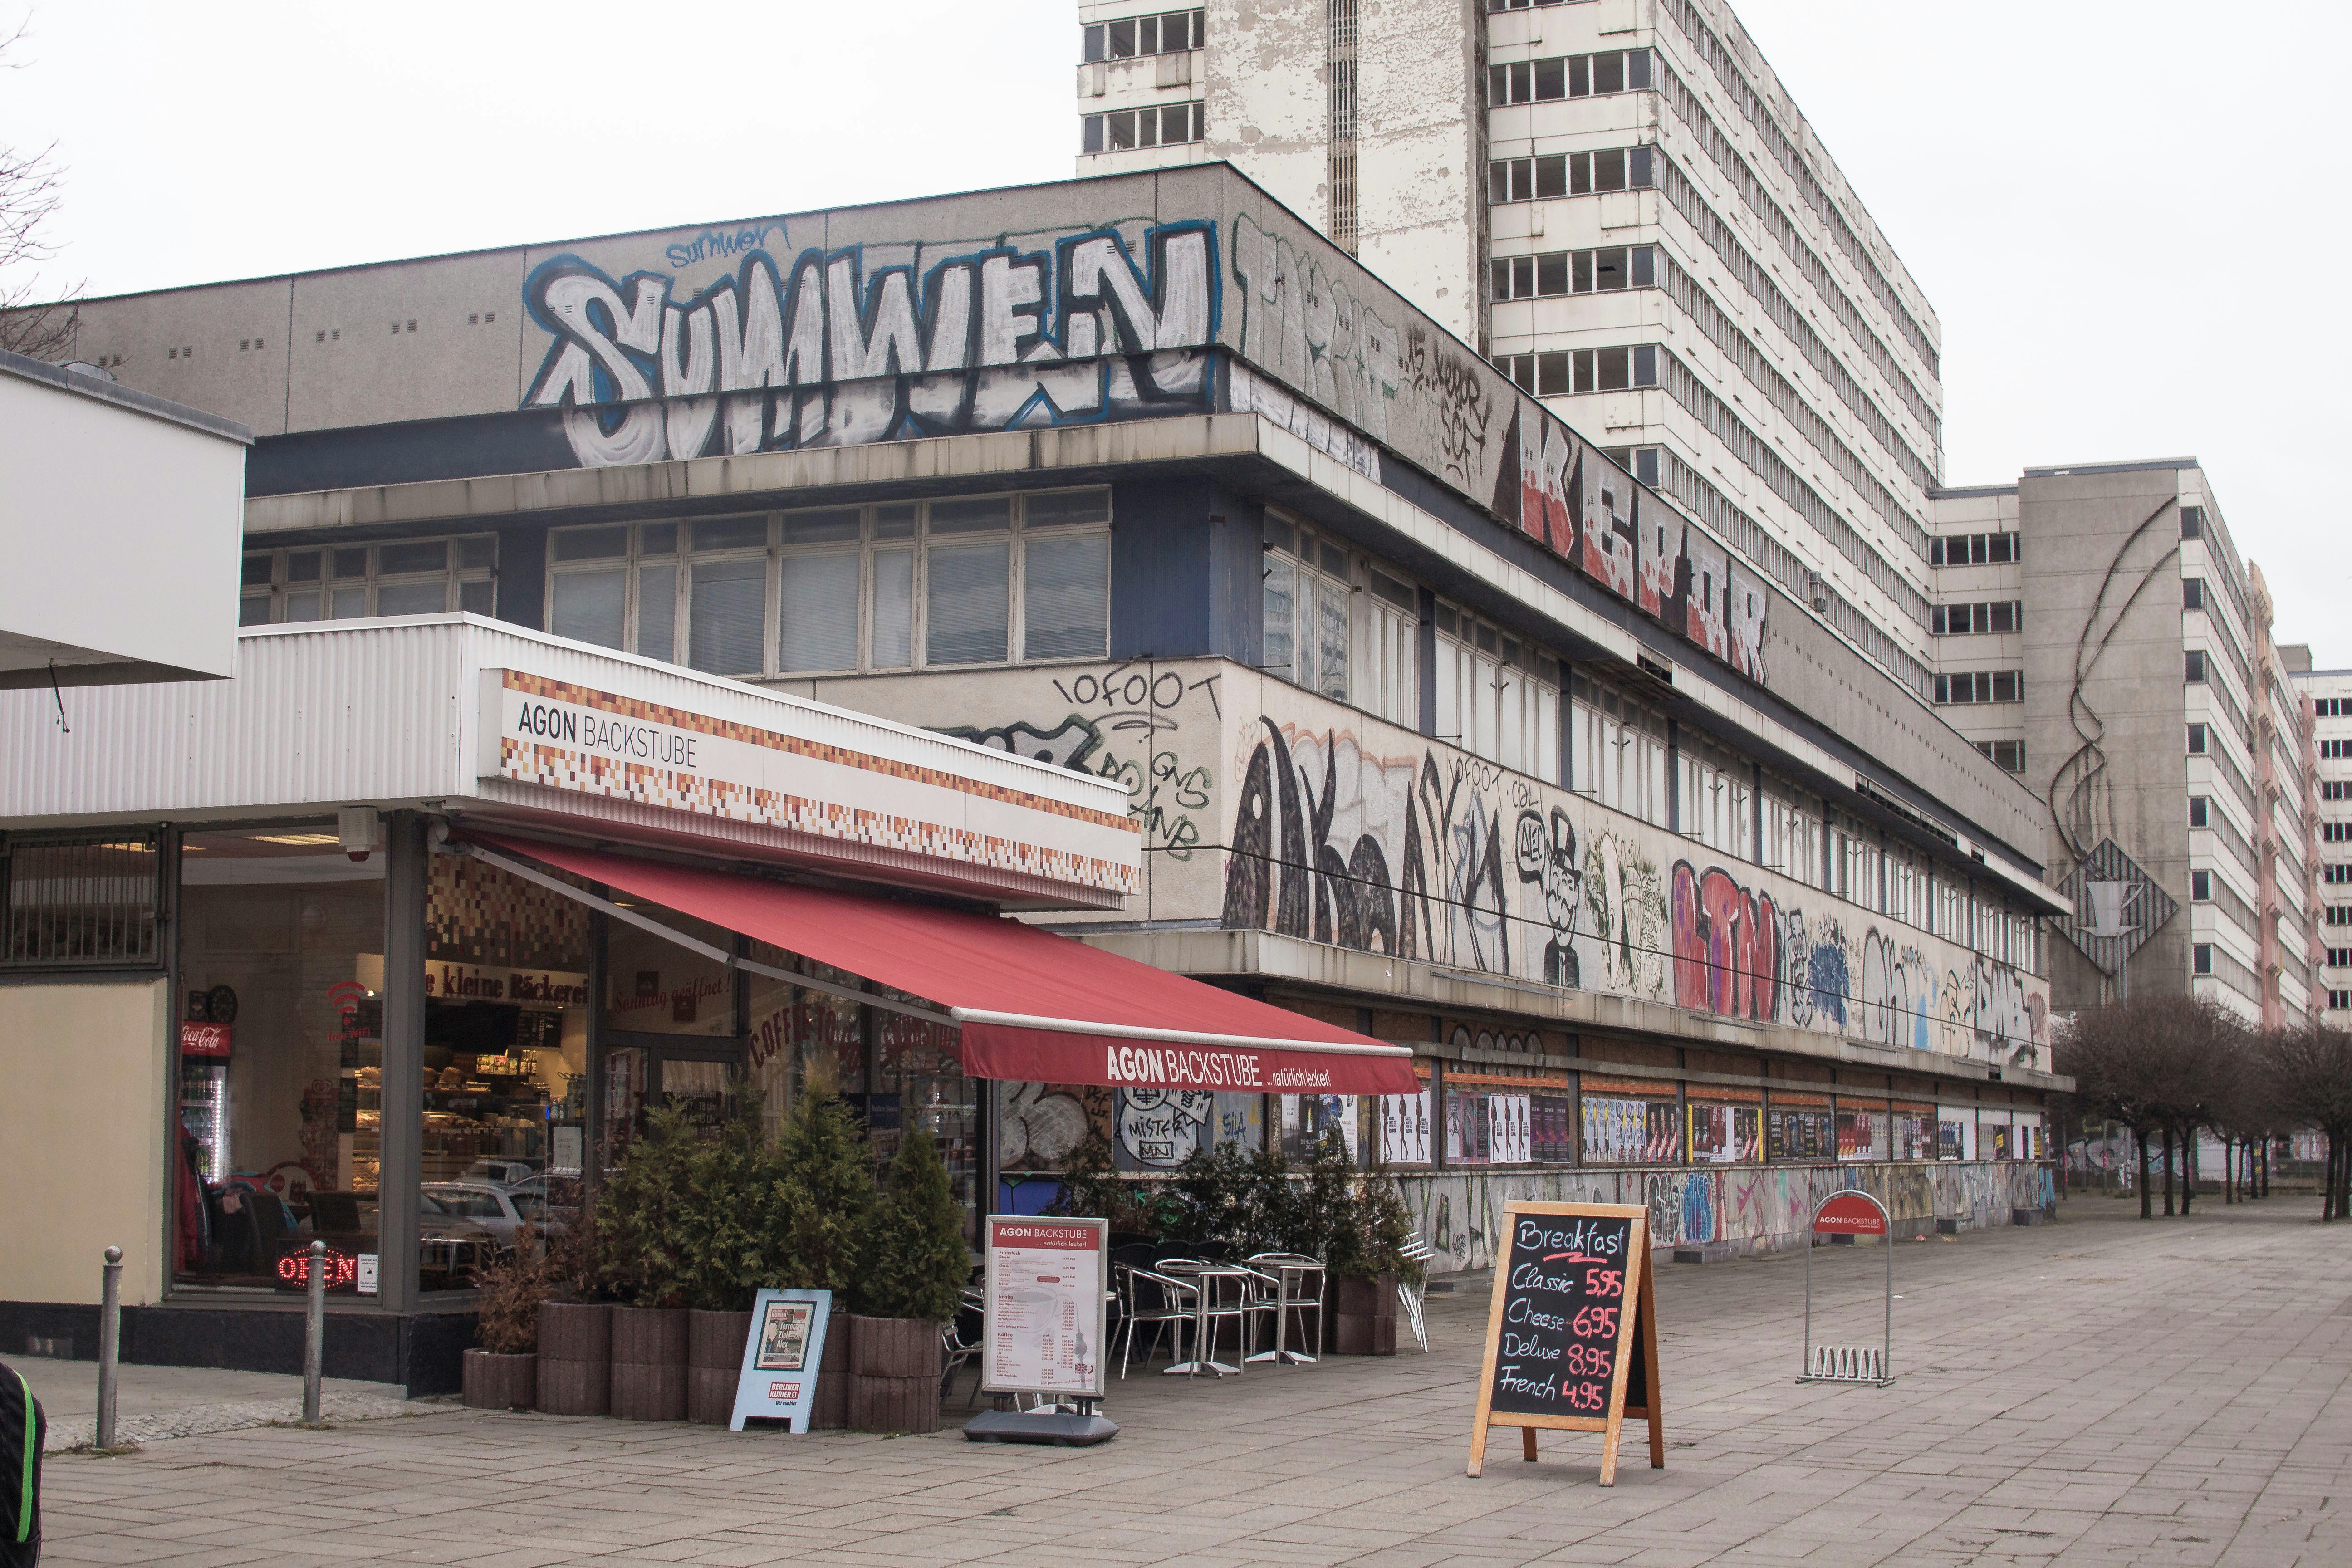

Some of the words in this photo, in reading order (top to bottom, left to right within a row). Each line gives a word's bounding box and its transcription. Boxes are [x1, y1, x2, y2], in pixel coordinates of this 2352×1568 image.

[518, 701, 576, 743] AGON
[584, 715, 697, 769] BACKSTUBE
[443, 965, 503, 998] kleine
[509, 973, 588, 1004] Bäckerei
[615, 990, 667, 1014] Sonntag
[671, 977, 723, 1004] geöffnet
[328, 1032, 347, 1042] free
[750, 1004, 810, 1069] COFFEE
[1107, 1045, 1166, 1083] AGON
[1165, 1049, 1263, 1087] BACKSTUBE
[1306, 1068, 1332, 1087] lecker!
[1000, 1227, 1031, 1237] AGON
[1034, 1228, 1087, 1239] BACKSTUBE
[1516, 1219, 1625, 1256] Breakfast
[279, 1256, 356, 1281] OPEN
[1512, 1262, 1574, 1294] Classic
[1585, 1268, 1623, 1297] 5,95
[1508, 1297, 1565, 1331] Cheese
[1572, 1306, 1618, 1339] 6,95
[1503, 1332, 1561, 1360] Deluxe
[1567, 1343, 1612, 1378] 8,95
[771, 1383, 799, 1391] BERLINER
[1499, 1365, 1556, 1401] French
[1562, 1381, 1604, 1411] 4,95
